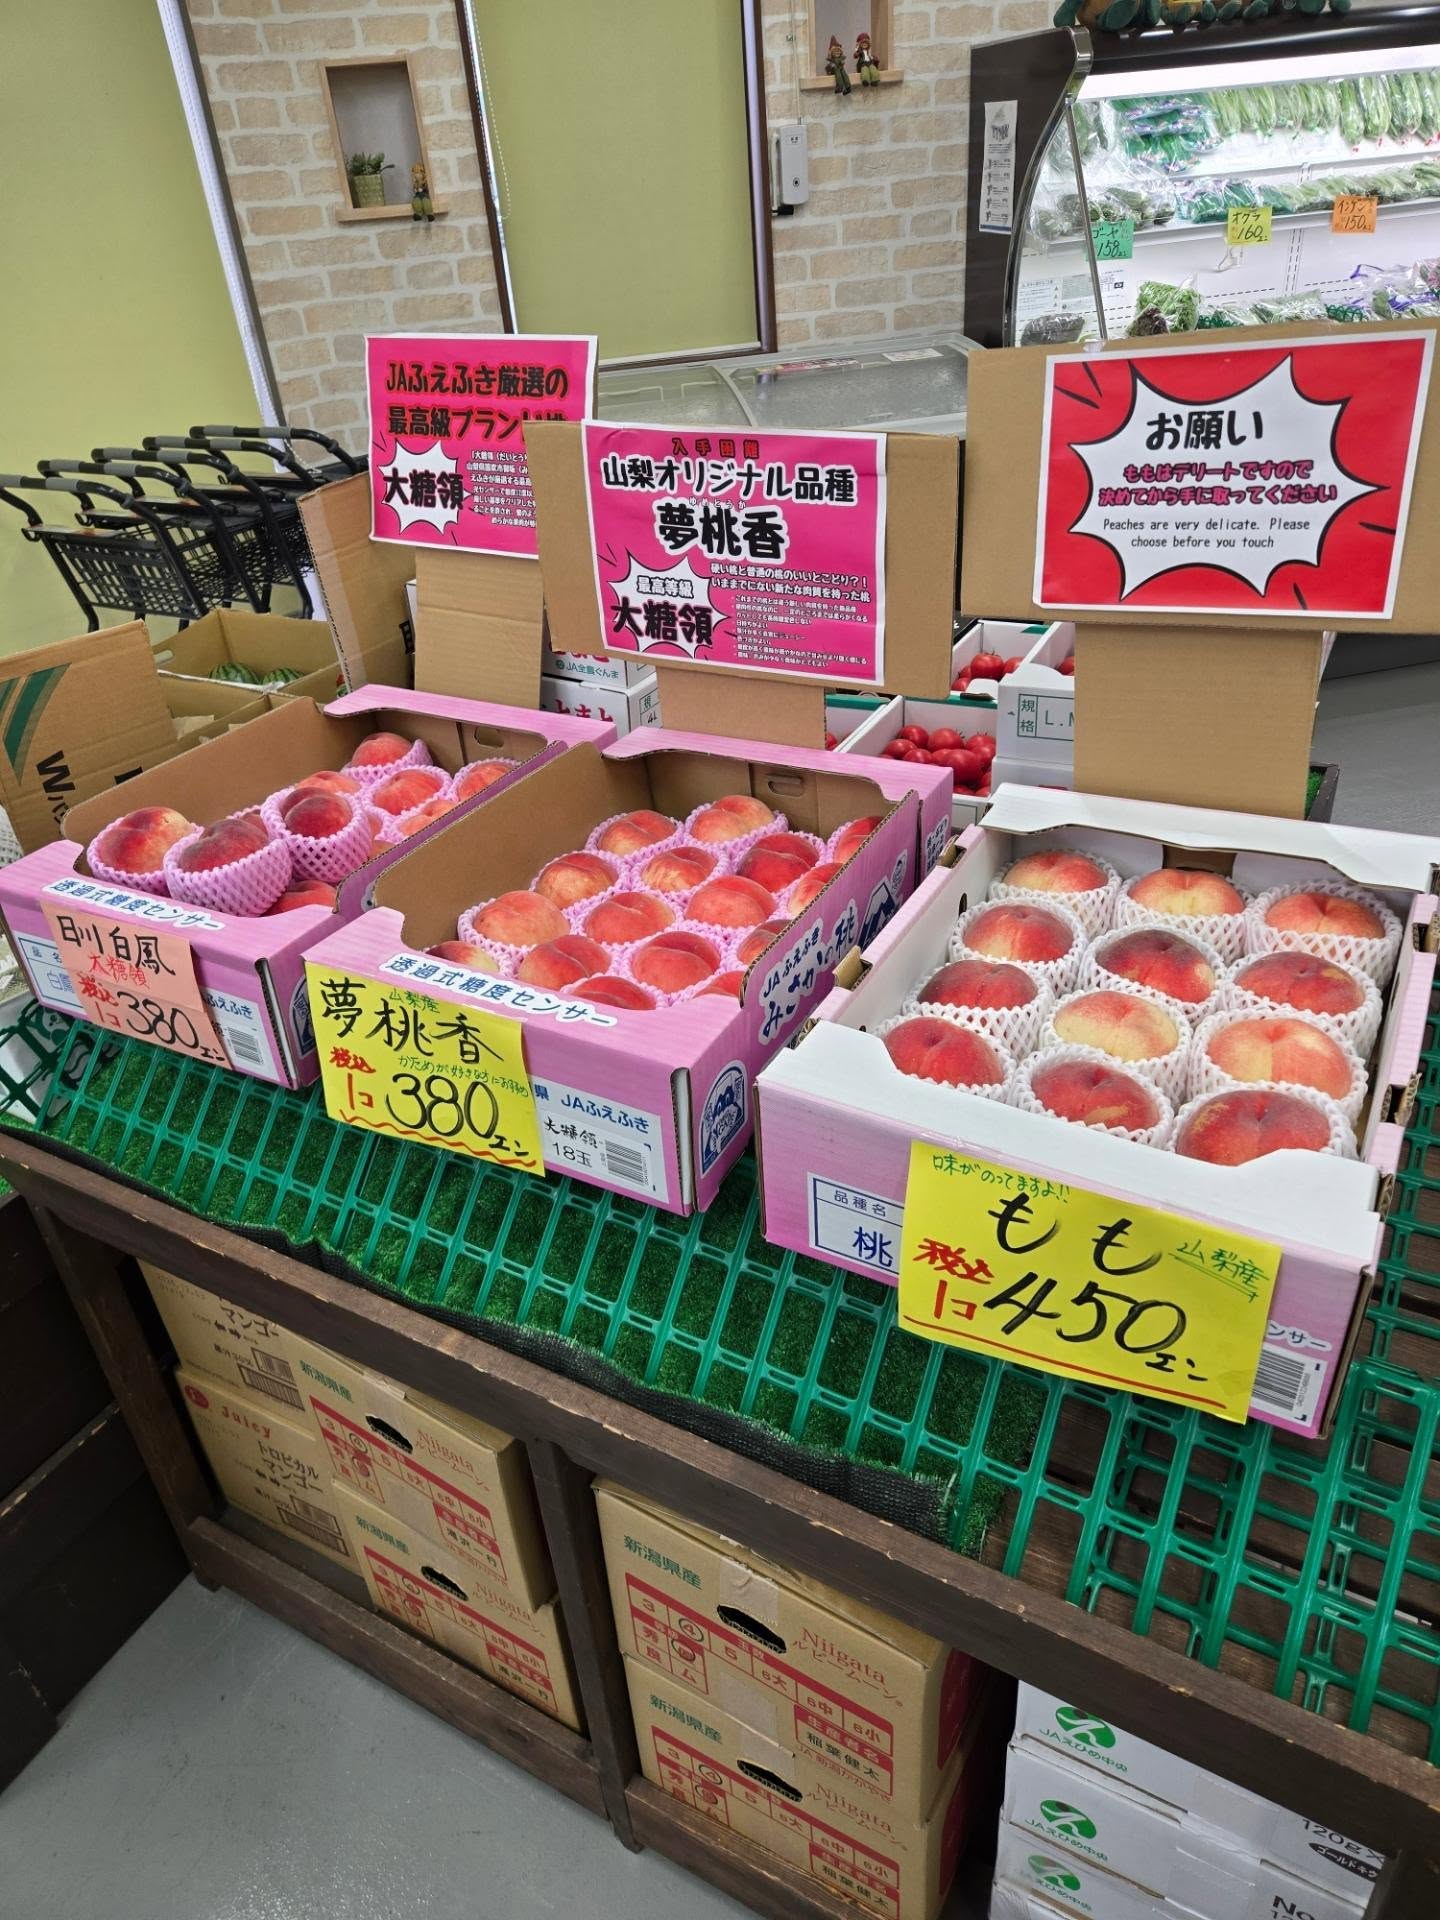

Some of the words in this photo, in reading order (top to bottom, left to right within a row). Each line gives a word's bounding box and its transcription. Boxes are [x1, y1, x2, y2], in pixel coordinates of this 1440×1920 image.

[1232, 211, 1260, 224] オクラ
[1339, 199, 1367, 214] インゲン
[387, 363, 568, 398] JAふえふき厳選の
[672, 437, 760, 458] 入手困難
[1146, 410, 1263, 450] お願い
[383, 467, 464, 509] 大糖領
[602, 456, 855, 502] 山梨オリジナル品種
[1123, 460, 1313, 483] ももはデリートですので
[689, 497, 746, 510] ゆめとうか
[1098, 484, 1338, 507] 決めてから手に取ってください
[656, 502, 785, 559] 夢桃香
[1103, 519, 1145, 531] Peaches
[1151, 520, 1168, 531] are
[1175, 520, 1199, 534] very
[1205, 518, 1260, 531] delicate.
[1269, 518, 1310, 531] Please
[1131, 536, 1167, 548] choose
[1173, 536, 1211, 548] before
[1216, 538, 1236, 550] you
[1242, 536, 1274, 548] touch
[637, 576, 693, 598] 最高等級
[611, 597, 713, 645] 大糖領
[567, 661, 619, 679] JA全農ぐんま
[1020, 699, 1036, 733] 規格
[50, 879, 222, 930] 透過式糖度センサー
[763, 926, 820, 998] JAふえふき
[388, 956, 612, 1026] 透過式糖度センサー
[320, 976, 504, 1065] 夢桃香
[534, 1084, 550, 1101] 県
[561, 1094, 649, 1134] JAふえふき
[543, 1116, 598, 1149] 大糖領
[552, 1142, 593, 1168] 18玉
[834, 1190, 886, 1217] 品種名
[852, 1226, 894, 1268] 桃
[988, 1192, 1162, 1276] もも
[912, 1238, 995, 1285] 税込
[1176, 1239, 1270, 1286] 山梨産
[934, 1279, 977, 1321] 1コ
[258, 1440, 319, 1480] トロピカル
[262, 1457, 324, 1493] マンゴー
[624, 1535, 702, 1590] 新潟県産
[642, 1598, 655, 1613] 3
[724, 1646, 738, 1661] 5
[853, 1722, 881, 1743] 6小
[803, 1628, 887, 1686] Niigata
[649, 1694, 722, 1745] 新潟県産
[1039, 1727, 1128, 1773] JAえひめ中央
[816, 1782, 893, 1833] Niigata
[1024, 1818, 1109, 1862] JAえひめ中央
